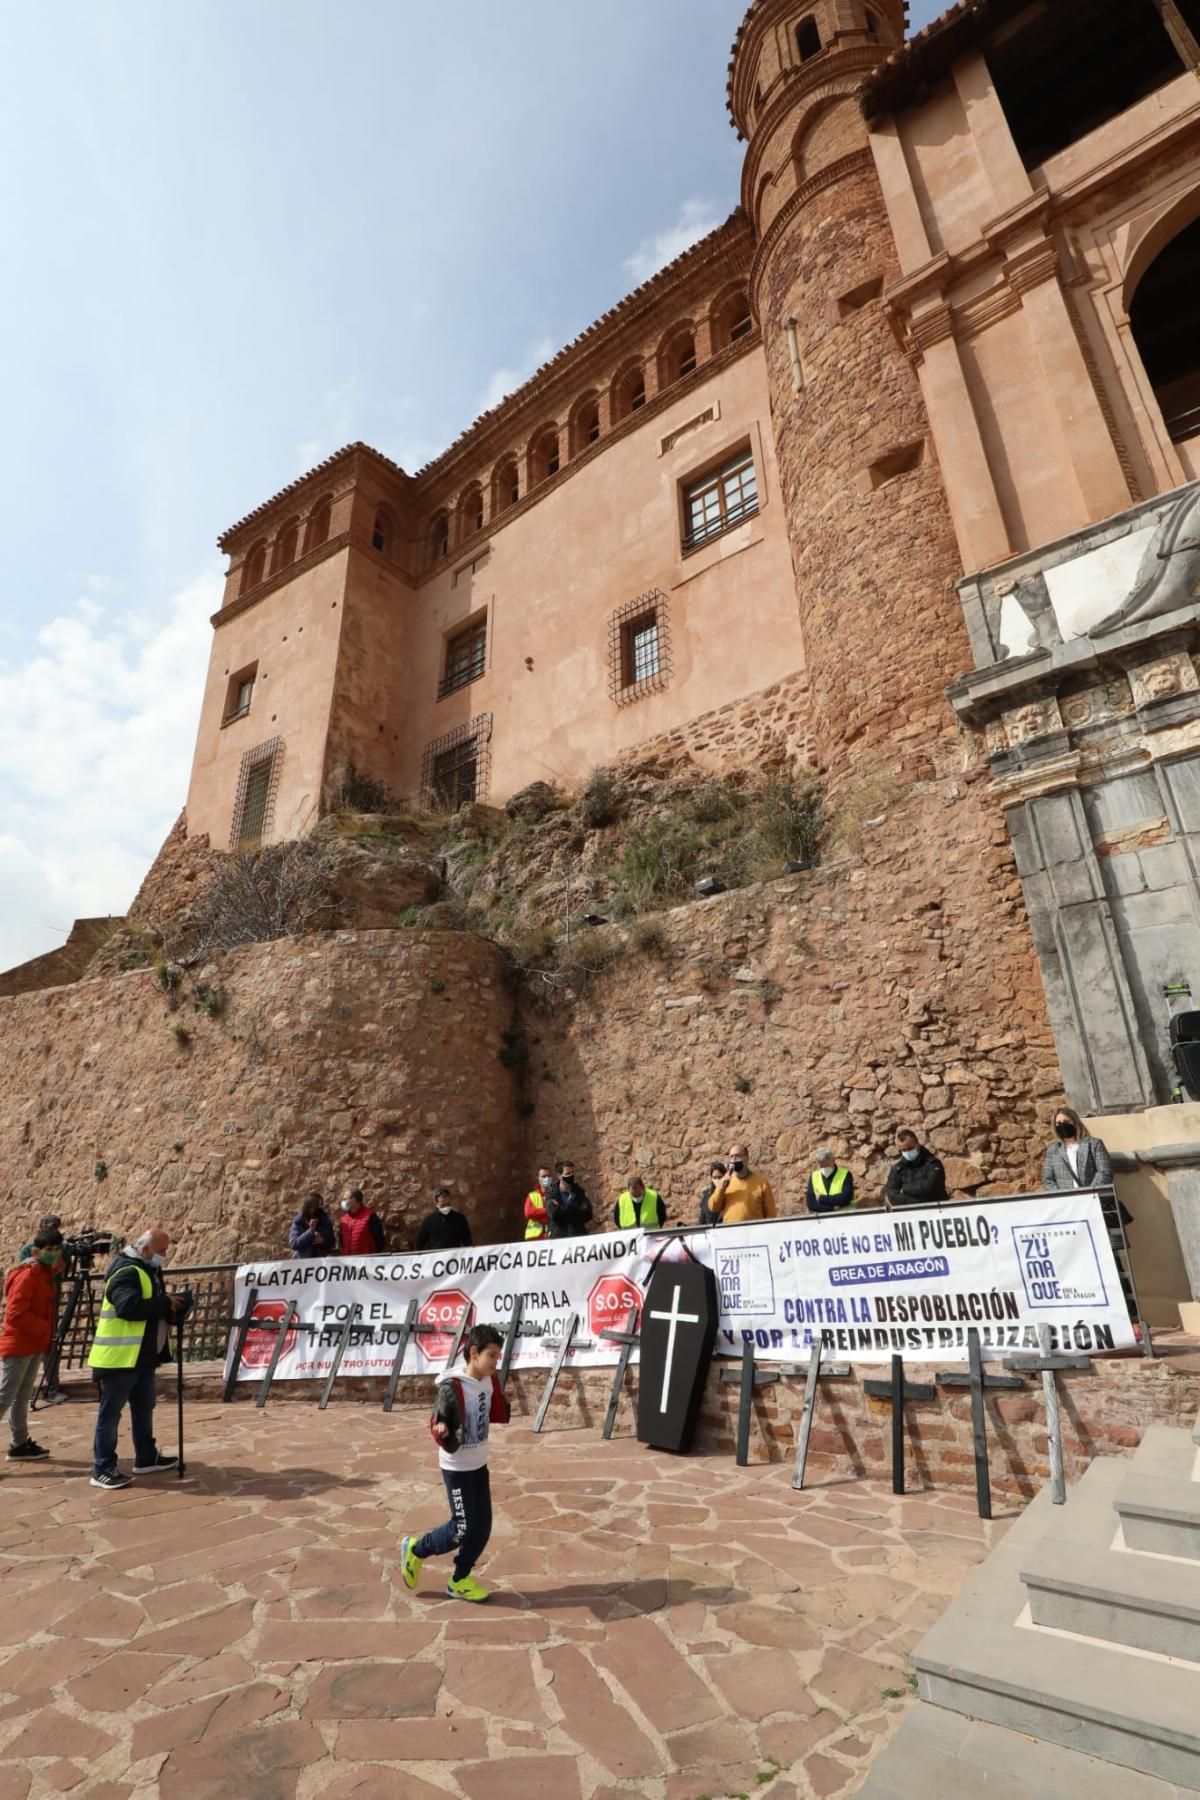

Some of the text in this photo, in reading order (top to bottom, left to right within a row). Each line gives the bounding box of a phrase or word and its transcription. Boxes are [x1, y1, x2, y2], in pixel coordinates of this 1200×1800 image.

[779, 1215, 999, 1263] ¿Y POR QUÉ NO EN MI PUEBLO?
[1021, 1238, 1050, 1259] ZU
[245, 1238, 638, 1287] PLATAFORMA S.O.S. COMARCA DEL ARANDA
[720, 1259, 740, 1275] ZU
[832, 1257, 945, 1282] BREA DE ARAGÓN
[1026, 1259, 1056, 1279] MA
[721, 1276, 740, 1291] MA
[494, 1290, 571, 1312] COTRA LA
[596, 1291, 638, 1311] S.O.S.
[784, 1287, 1020, 1324] CONTRA LA DESPOBLACIÓN
[322, 1303, 392, 1321] POR EL
[721, 1329, 735, 1345] Y
[742, 1329, 784, 1349] POR
[791, 1328, 815, 1349] LA
[452, 1488, 465, 1518] BEST
